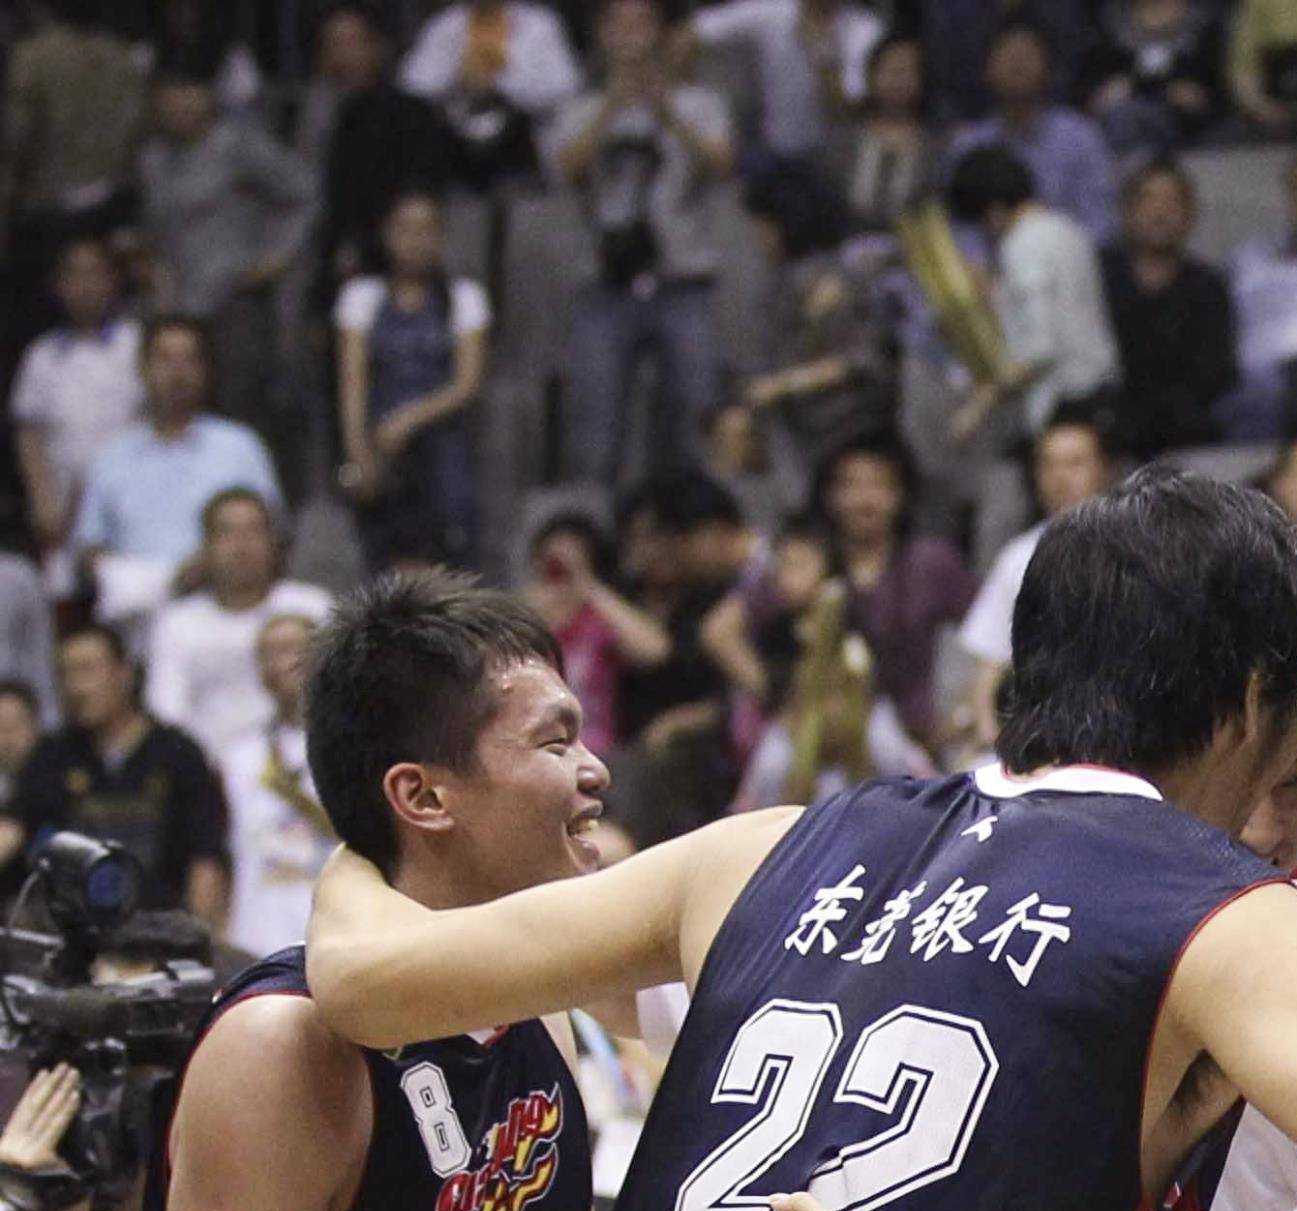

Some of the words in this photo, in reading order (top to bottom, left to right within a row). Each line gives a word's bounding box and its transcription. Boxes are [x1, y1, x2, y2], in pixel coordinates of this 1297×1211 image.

[784, 865, 1072, 987] 东莞银行
[400, 1061, 472, 1179] 8
